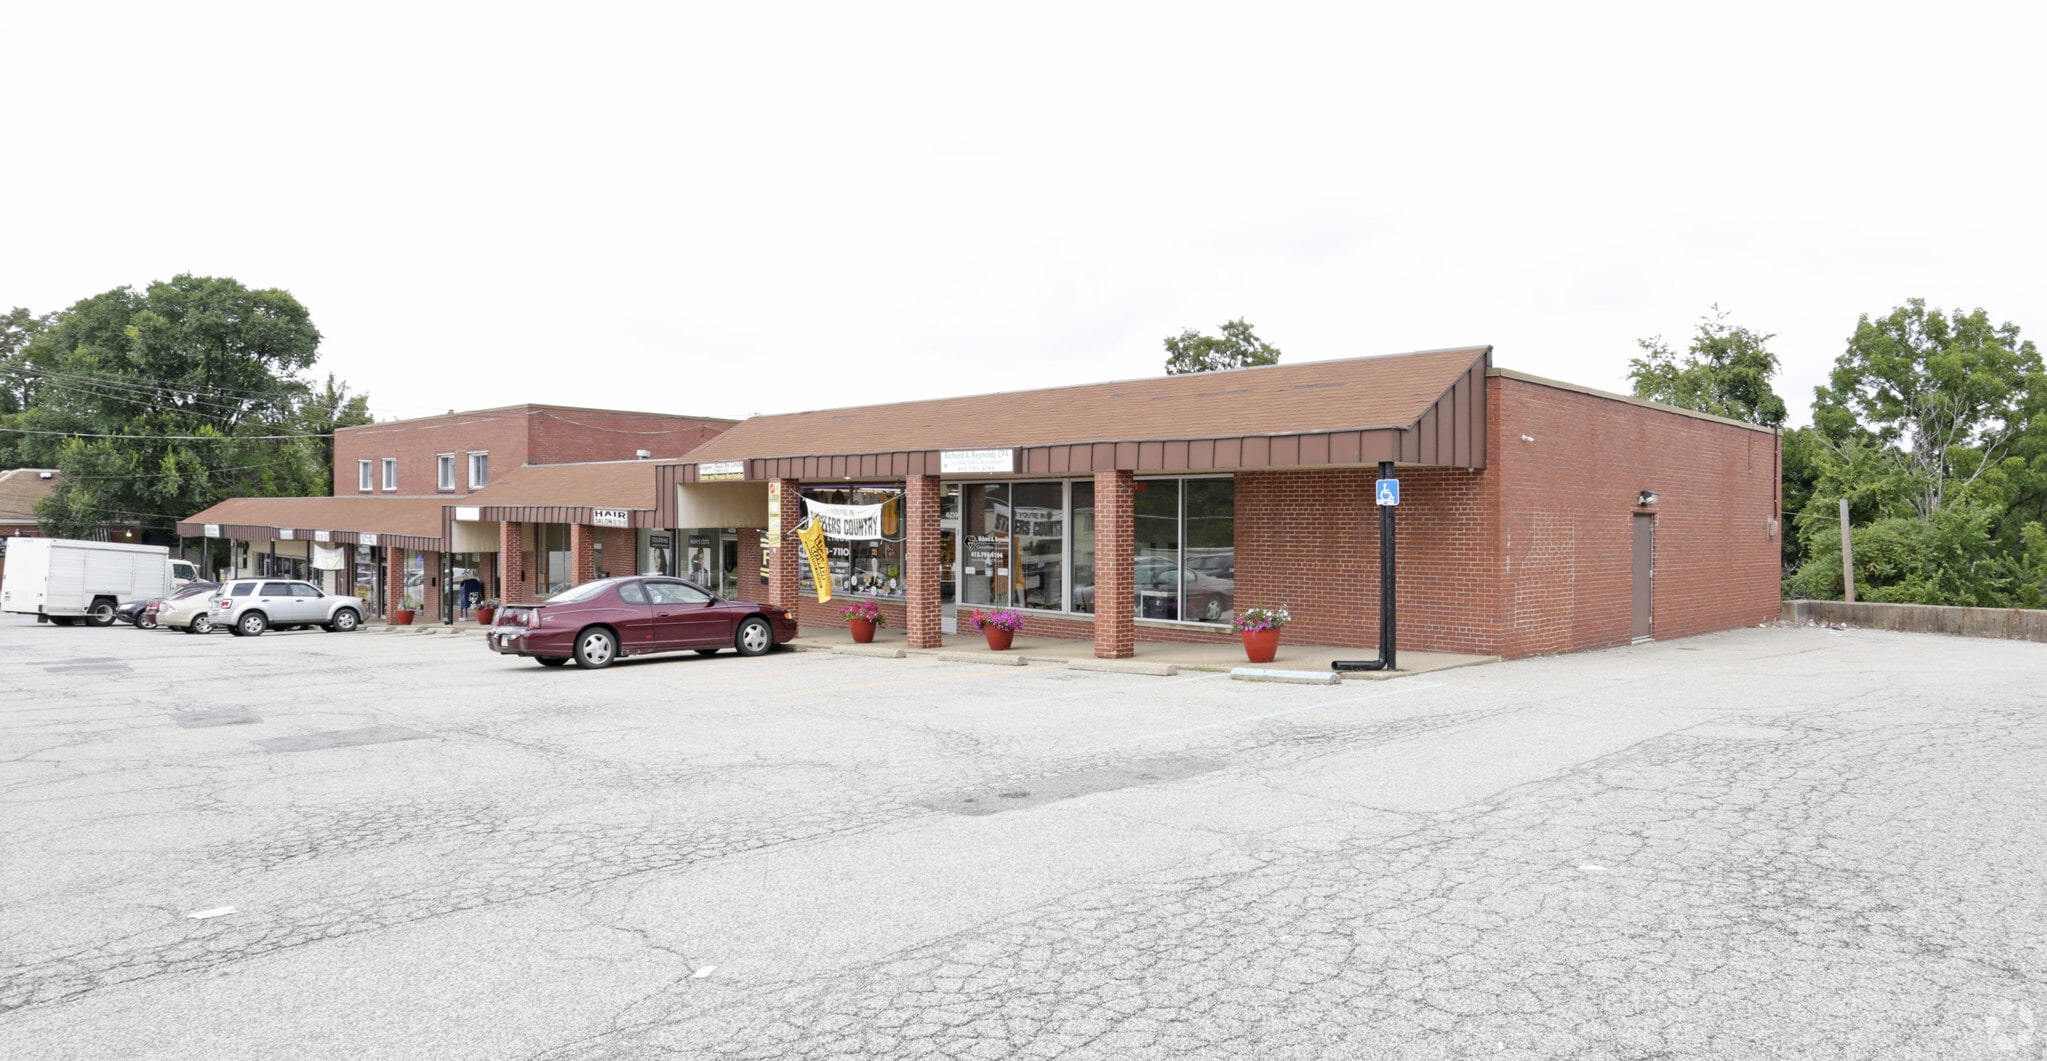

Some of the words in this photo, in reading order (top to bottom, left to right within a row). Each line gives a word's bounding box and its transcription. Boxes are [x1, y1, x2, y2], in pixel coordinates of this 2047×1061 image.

[997, 449, 1009, 457] CPA
[595, 510, 626, 519] HAIR
[843, 515, 877, 537] COUNTRY
